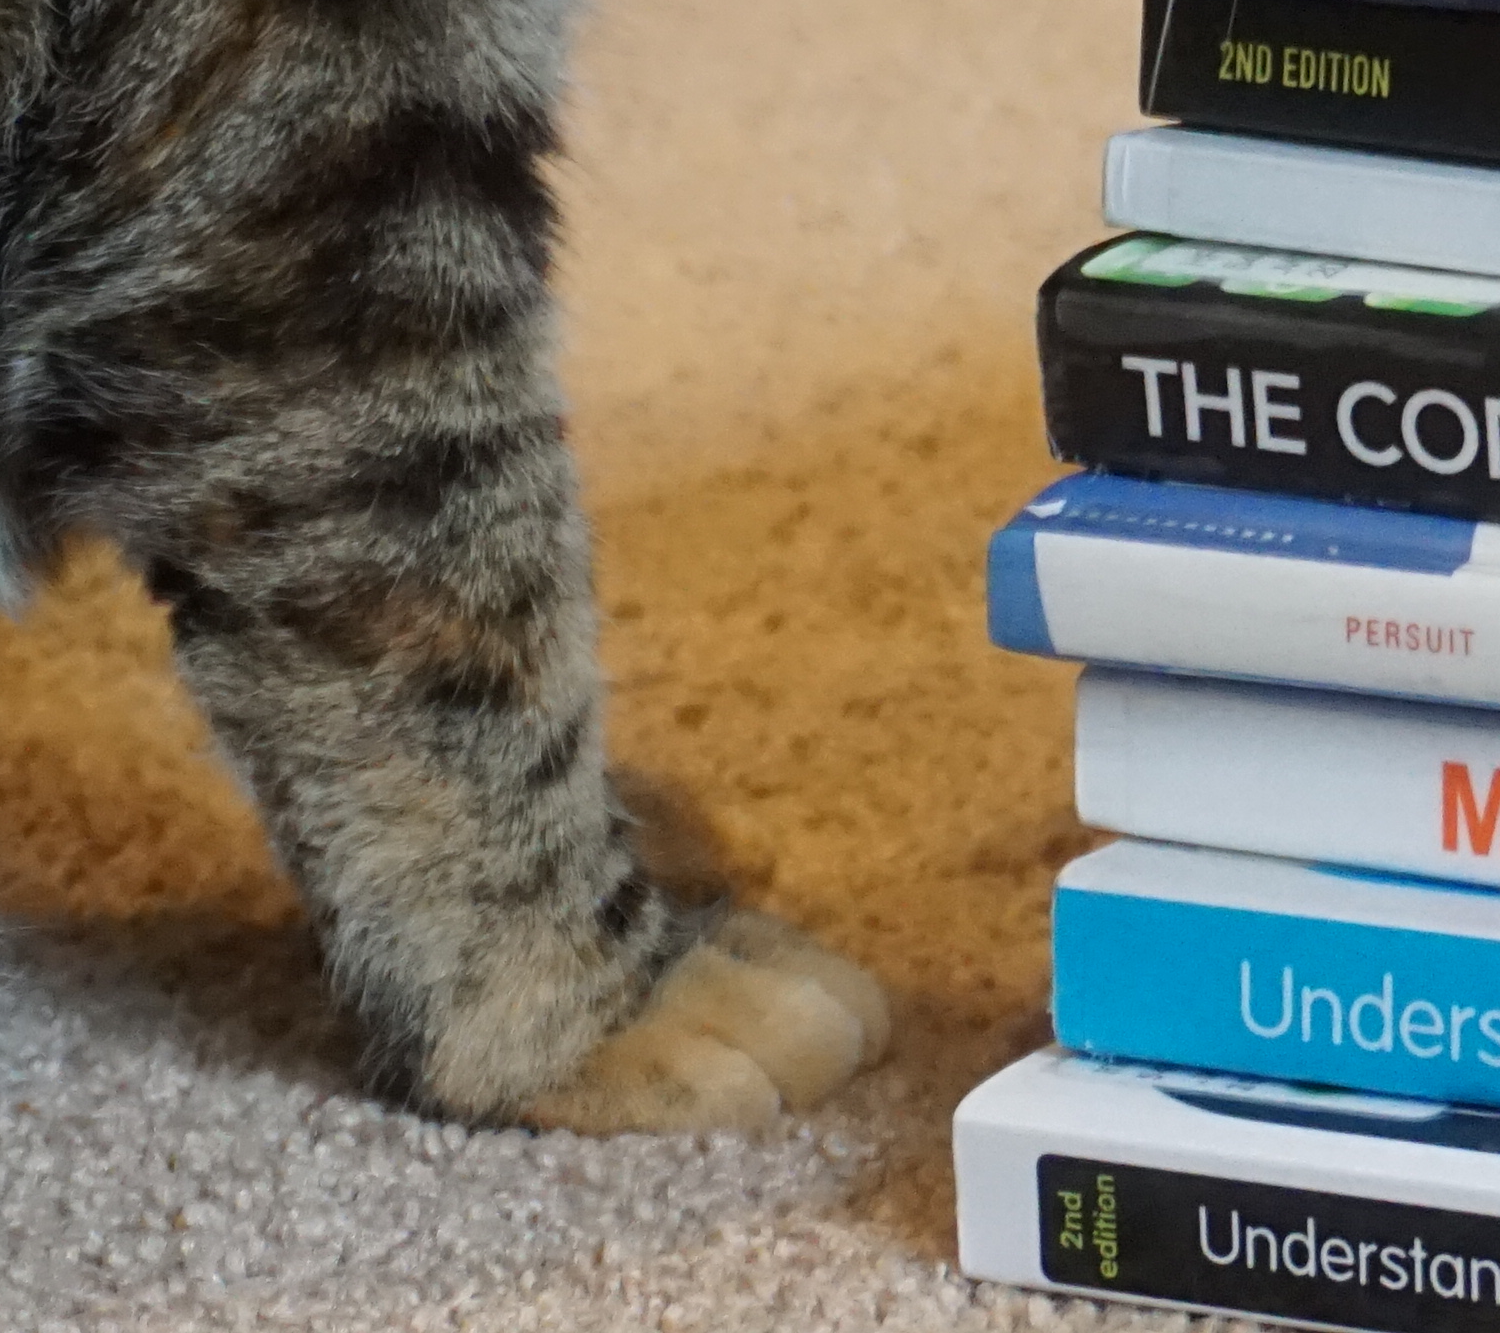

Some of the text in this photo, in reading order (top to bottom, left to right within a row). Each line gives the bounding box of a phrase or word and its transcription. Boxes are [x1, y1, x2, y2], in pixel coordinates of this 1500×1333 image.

[1220, 40, 1390, 98] 2ND EDITION
[1122, 355, 1308, 456] THE
[1346, 617, 1474, 656] PERSUIT
[1058, 1189, 1083, 1250] 2nd
[1093, 1174, 1119, 1278] edition
